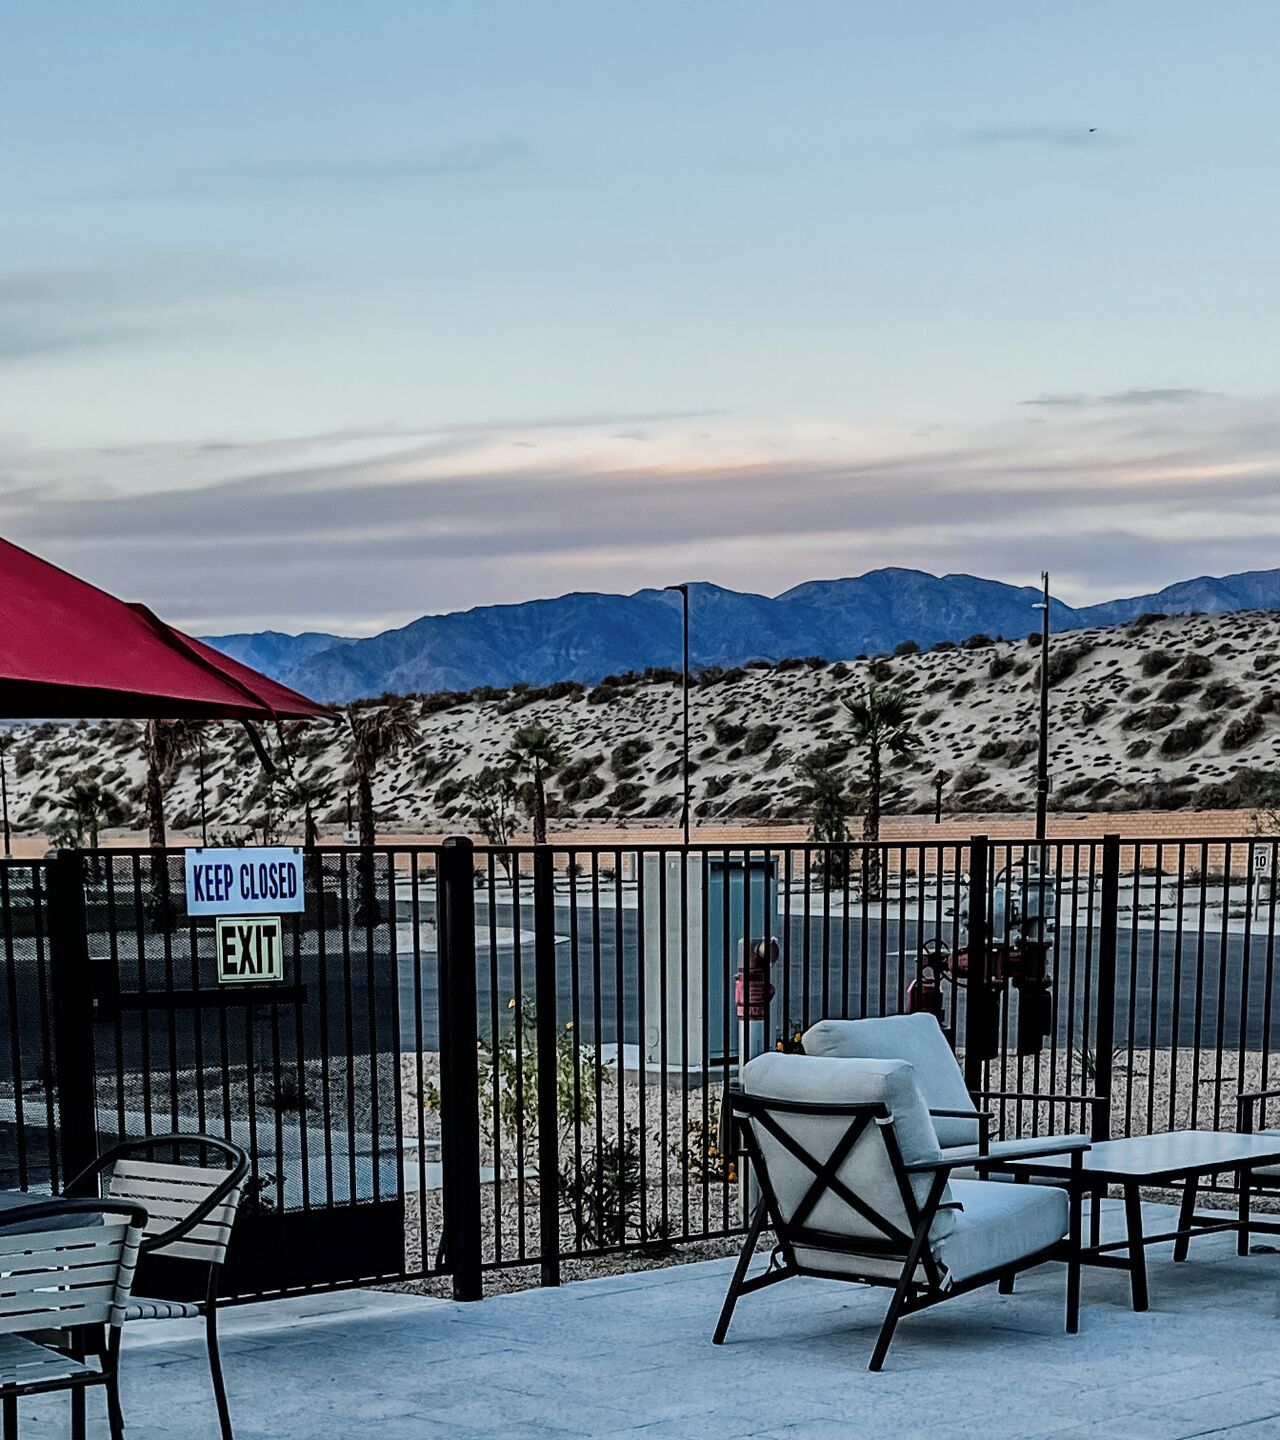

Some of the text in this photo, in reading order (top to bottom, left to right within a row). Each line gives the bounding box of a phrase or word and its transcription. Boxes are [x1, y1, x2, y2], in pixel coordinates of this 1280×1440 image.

[193, 861, 297, 902] KEEP CLOSED
[1255, 856, 1266, 867] 10
[221, 924, 277, 976] EXIT
